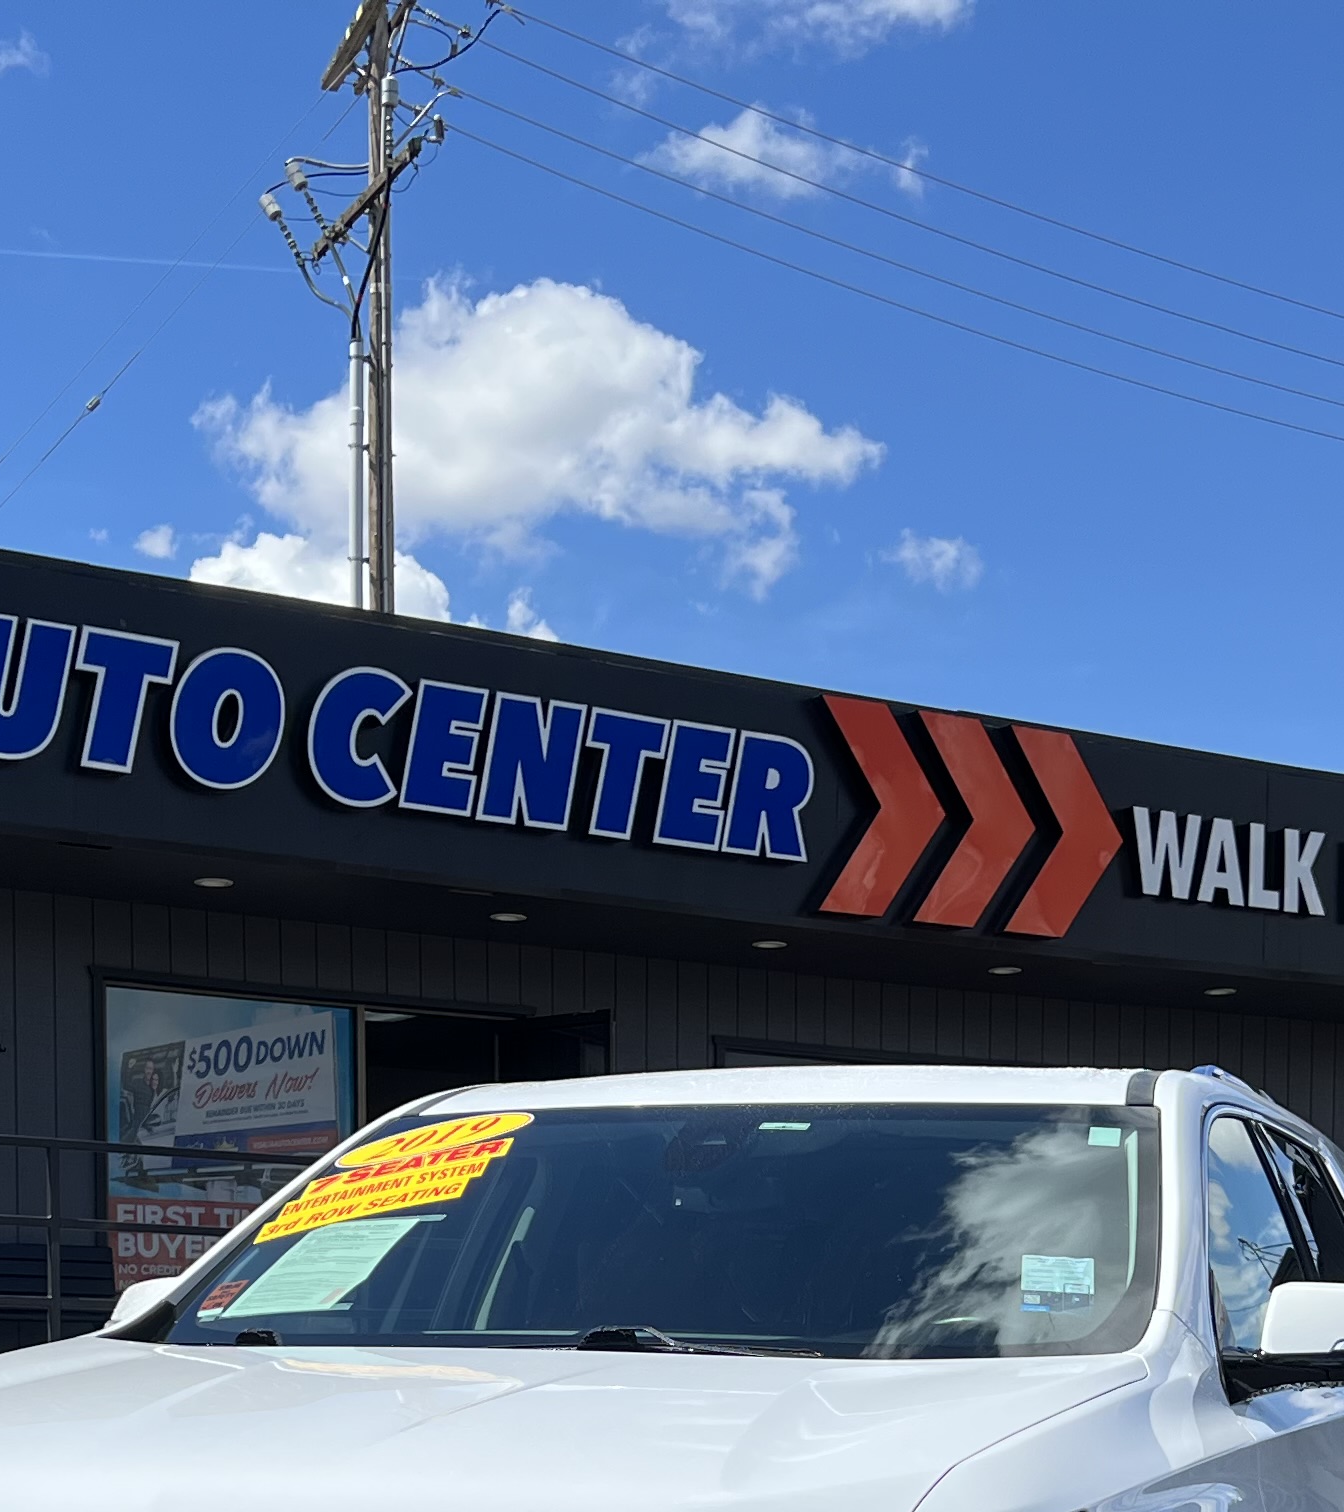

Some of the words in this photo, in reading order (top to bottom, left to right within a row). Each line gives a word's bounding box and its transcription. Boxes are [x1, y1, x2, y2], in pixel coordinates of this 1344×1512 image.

[307, 665, 814, 864] CENTER
[1131, 805, 1327, 917] WALK
[187, 1035, 253, 1079] $500
[255, 1029, 326, 1066] DOWN
[264, 1067, 320, 1100] Now!
[205, 1106, 239, 1119] REMAINDER
[240, 1105, 252, 1115] DUE
[253, 1102, 276, 1114] WITHIN
[287, 1099, 305, 1110] DAYS
[366, 1116, 502, 1161] 2019
[281, 1177, 411, 1217] ENTERTAINMENT
[416, 1161, 486, 1185] SYSTEM
[309, 1174, 343, 1195] 7
[343, 1139, 508, 1185] SEATER
[116, 1203, 206, 1227] FIRST
[262, 1216, 301, 1238] 3rd
[306, 1203, 358, 1224] ROW
[363, 1182, 463, 1212] SEATING
[118, 1263, 138, 1275] NO
[141, 1263, 182, 1276] CREDIT
